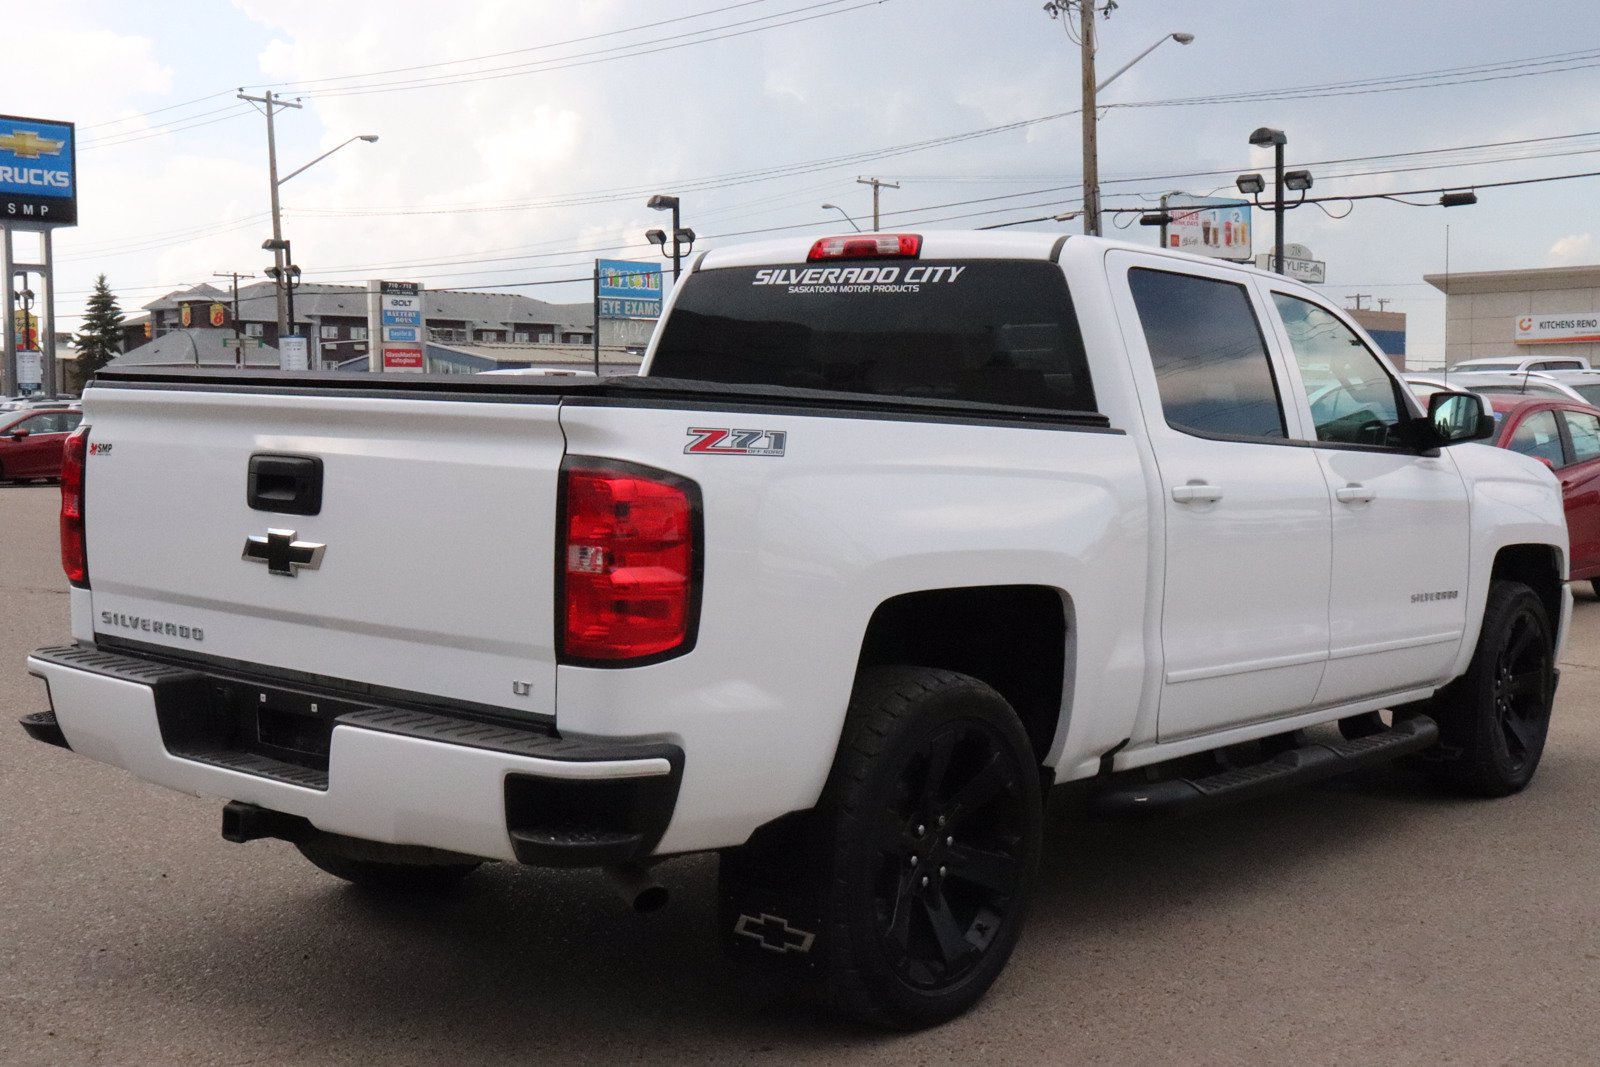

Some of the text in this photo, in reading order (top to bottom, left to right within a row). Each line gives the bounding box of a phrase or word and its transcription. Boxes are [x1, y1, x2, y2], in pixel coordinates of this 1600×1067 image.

[1272, 258, 1310, 273] CYLIFE
[752, 266, 966, 285] SILVERADO CITY
[788, 284, 920, 294] SASKATOON MOTOR PRODUCTS
[602, 301, 660, 316] EYE EXAMS
[1540, 319, 1598, 329] KITCHENS RENO
[97, 443, 113, 453] SMP
[683, 427, 787, 457] Z71
[1410, 590, 1459, 603] SILVERADO
[101, 611, 204, 641] SILVERADO
[512, 680, 532, 697] LT
